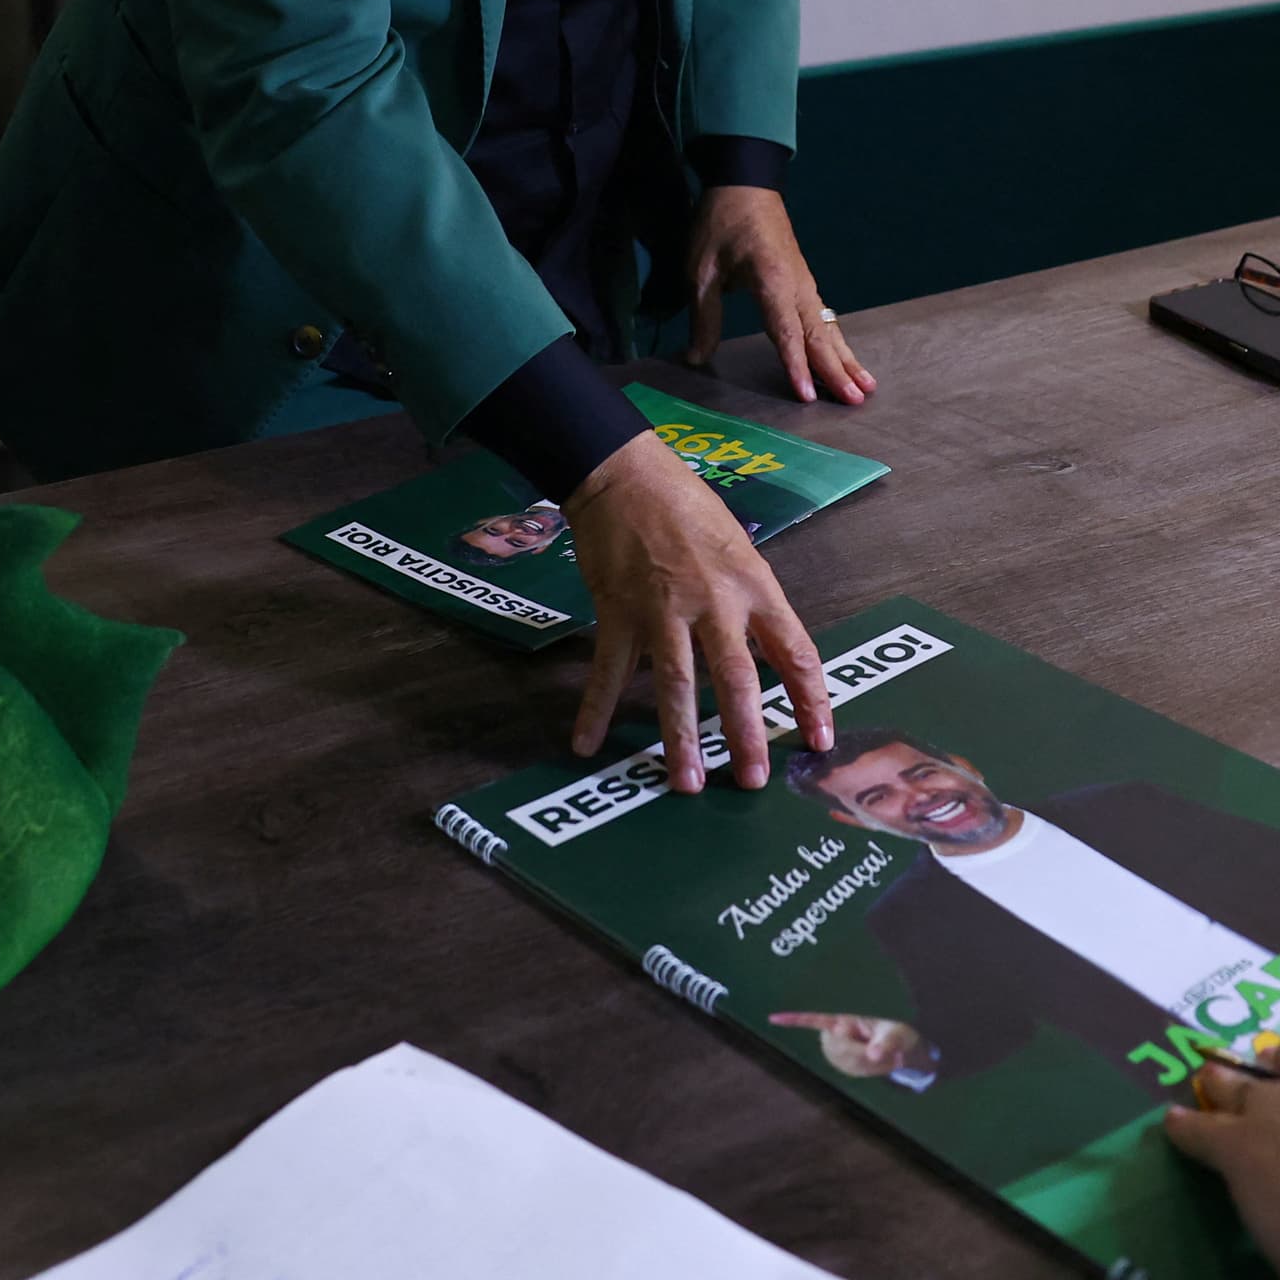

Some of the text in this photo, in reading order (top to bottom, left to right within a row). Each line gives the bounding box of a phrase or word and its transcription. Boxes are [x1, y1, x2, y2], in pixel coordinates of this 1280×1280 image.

[655, 423, 785, 476] 4499
[338, 527, 558, 625] RESSUSCITA RIO!
[829, 633, 934, 688] RIO!
[718, 834, 845, 940] Ainda há
[770, 840, 893, 957] esperança!
